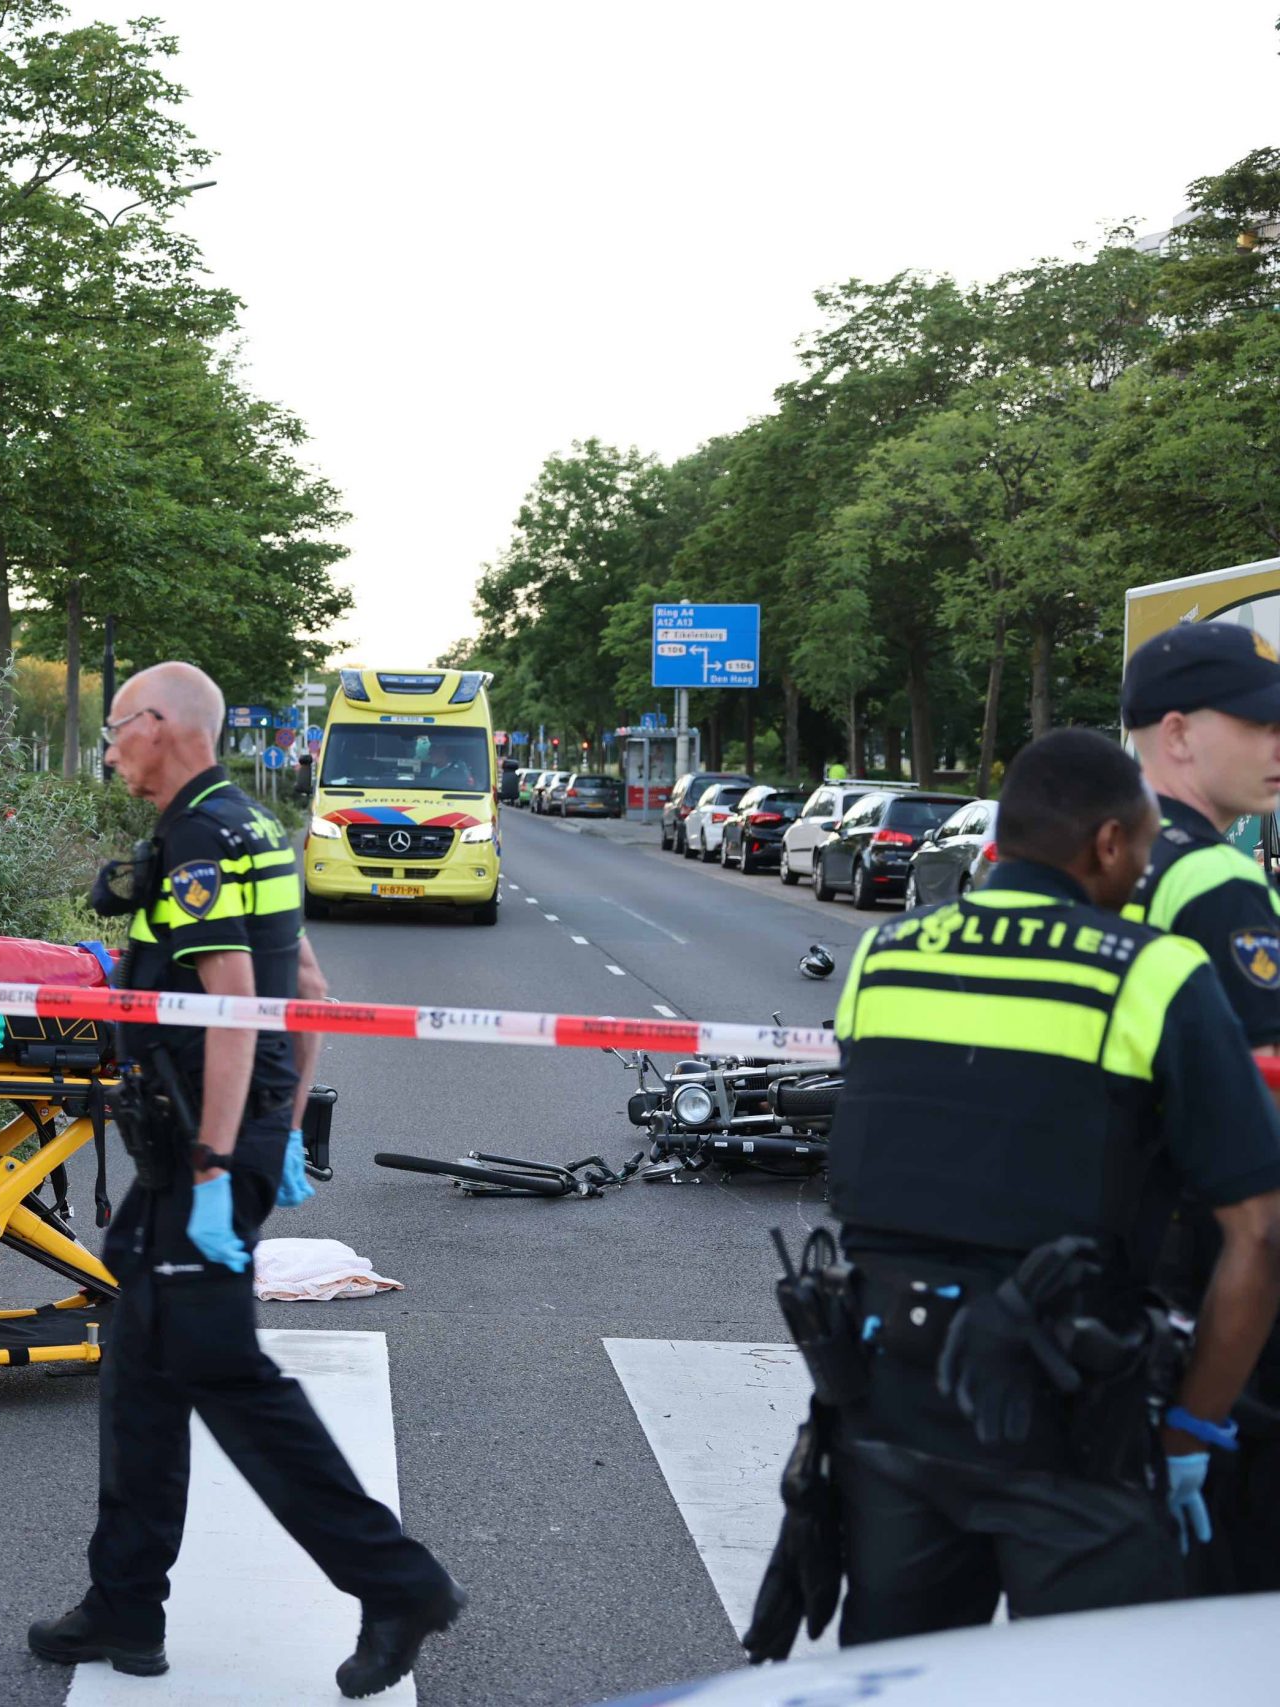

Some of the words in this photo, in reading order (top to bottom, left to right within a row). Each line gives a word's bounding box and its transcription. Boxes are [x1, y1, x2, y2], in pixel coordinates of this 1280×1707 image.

[657, 608, 679, 619] Ring
[681, 608, 695, 617] A4
[656, 618, 674, 627] A12
[676, 618, 694, 627] A13
[710, 675, 728, 684] Den
[730, 675, 753, 685] Haag
[352, 797, 456, 807] AMBULANCE
[894, 903, 1105, 953] POLITIE
[295, 1005, 377, 1022] BETREDEN
[417, 1011, 503, 1029] POLITIE
